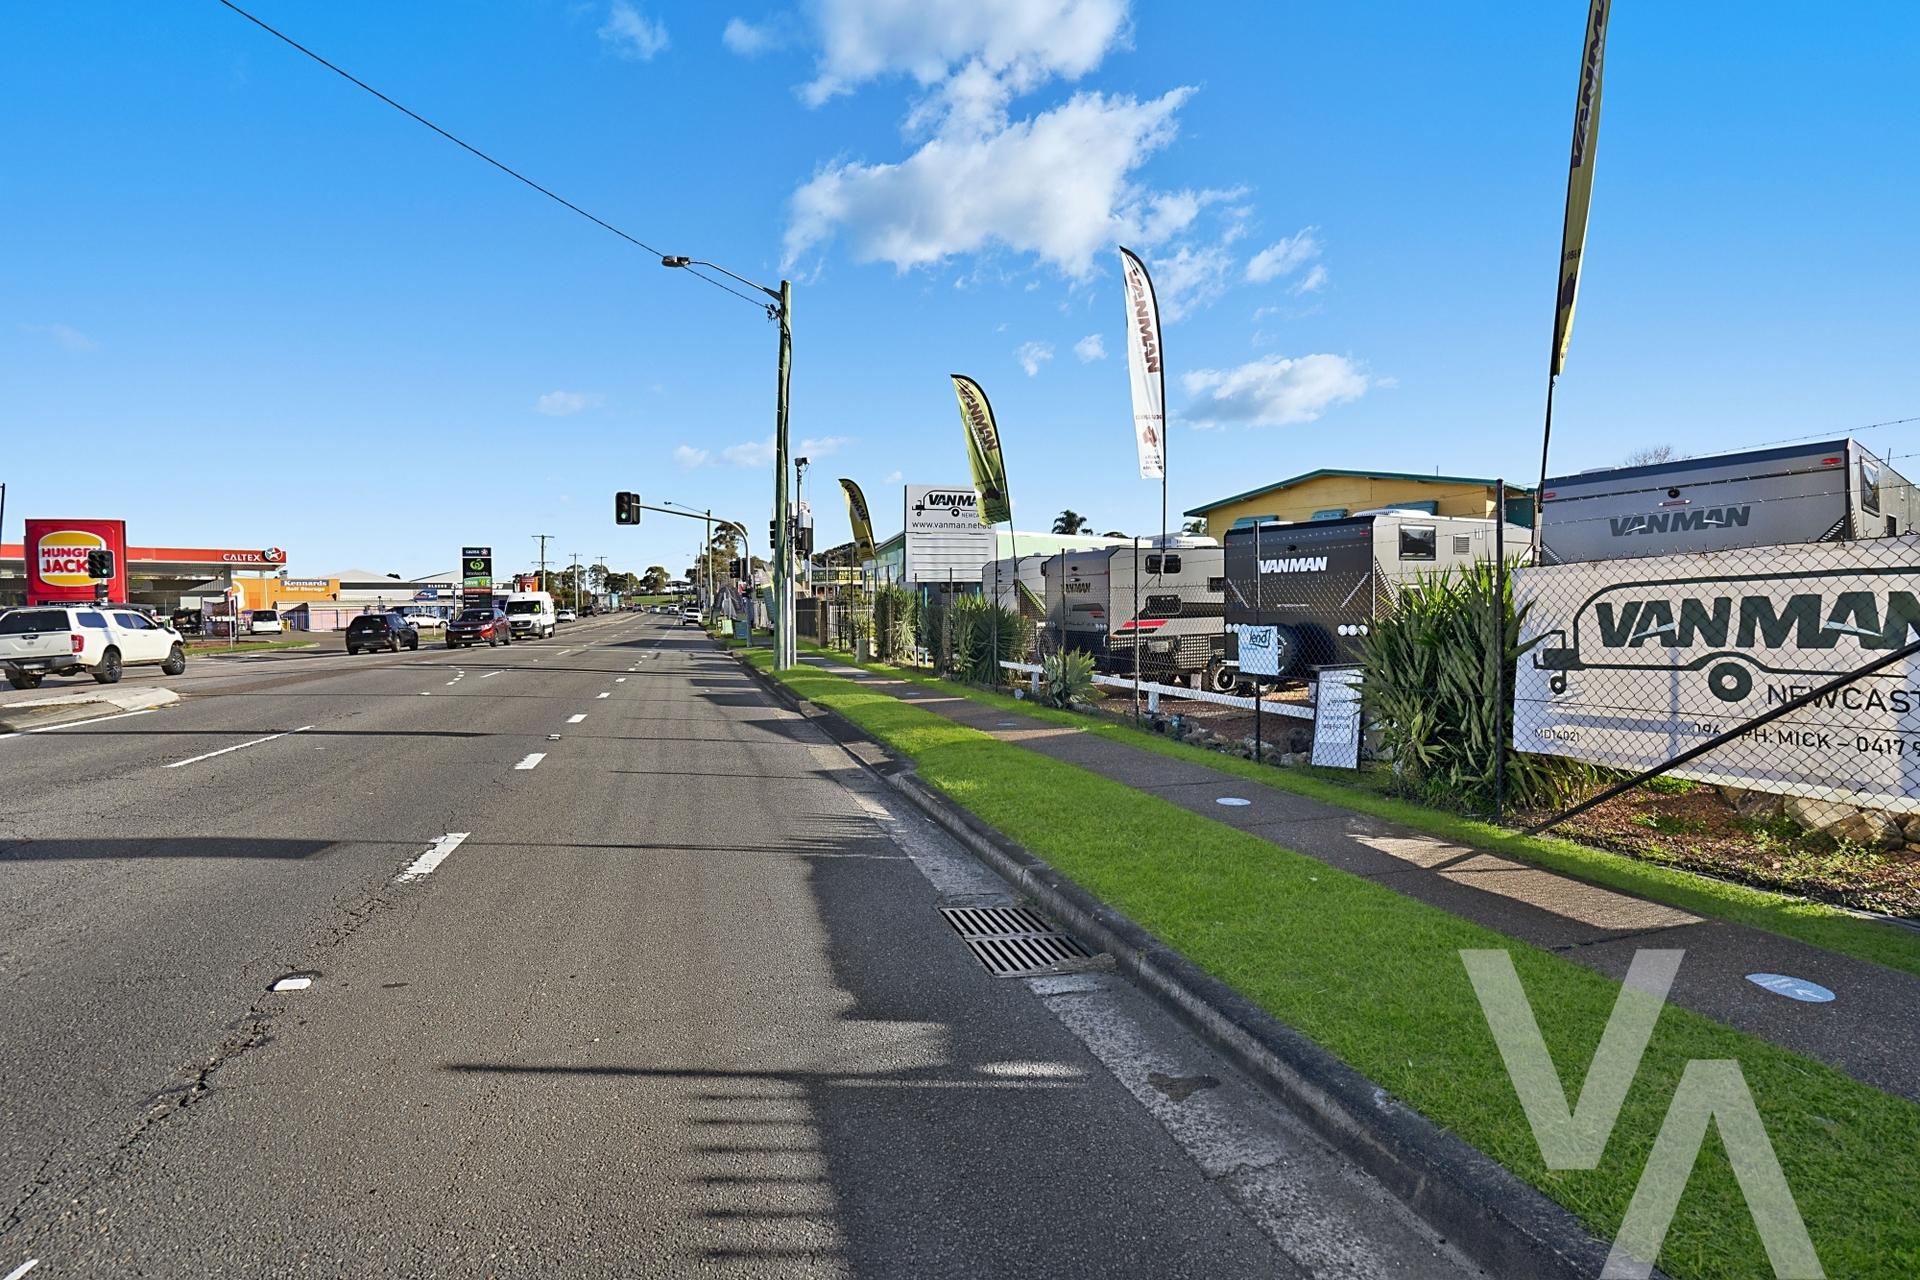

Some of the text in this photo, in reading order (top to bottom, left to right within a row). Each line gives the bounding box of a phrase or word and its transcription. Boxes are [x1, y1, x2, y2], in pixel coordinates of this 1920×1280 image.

[1610, 506, 1751, 537] VANMAN
[42, 547, 101, 558] HUNG
[222, 553, 261, 562] CALTEX
[1258, 556, 1328, 574] VANMAN
[1534, 728, 1580, 743] MD14021
[1778, 731, 1831, 750] MICK
[1856, 736, 1905, 757] 0417
